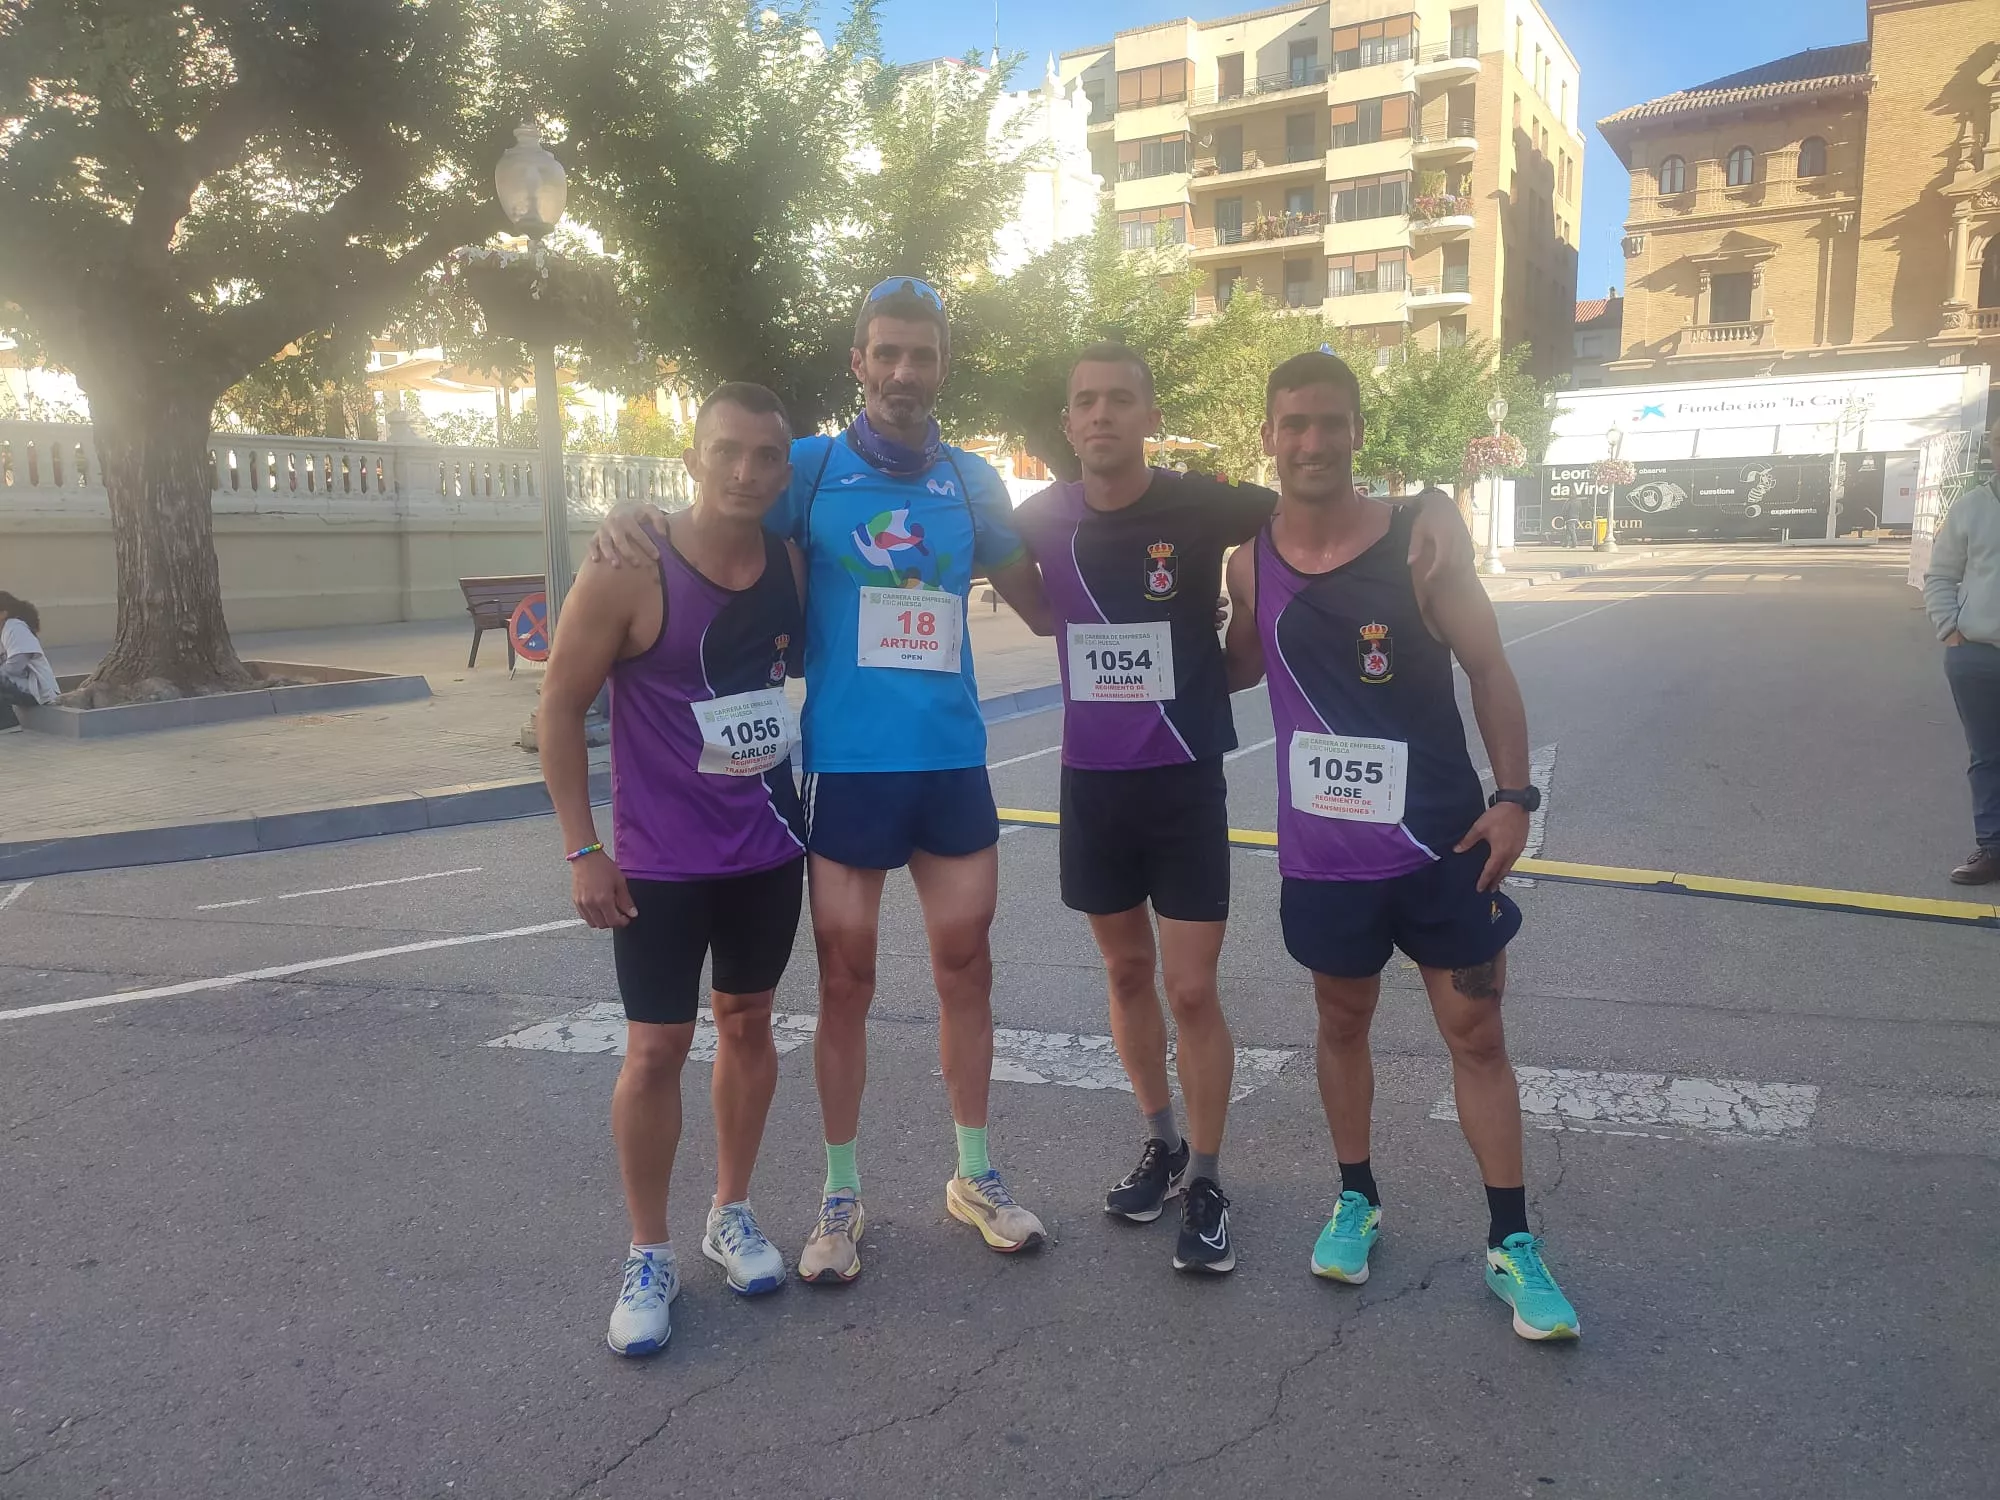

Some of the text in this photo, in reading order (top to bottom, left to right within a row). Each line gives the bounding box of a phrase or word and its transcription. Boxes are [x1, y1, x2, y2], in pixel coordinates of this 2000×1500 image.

[1678, 400, 1777, 413] Fundación
[1550, 481, 1610, 496] da Vinc
[1699, 488, 1735, 496] cuestiona
[1770, 507, 1818, 516] experimenta
[882, 593, 912, 601] CARRERA
[897, 610, 936, 636] 18
[880, 637, 939, 651] ARTURO
[900, 653, 923, 661] OPEN
[1085, 649, 1153, 671] 1054
[720, 716, 780, 747] 1056
[731, 743, 777, 760] CARLOS
[1324, 746, 1350, 754] HUESCA
[1349, 742, 1386, 750] EMPRESAS
[1308, 756, 1383, 784] 1055
[1323, 785, 1363, 799] JOSE
[1315, 794, 1360, 806] REGIMIENTO
[1311, 802, 1370, 815] TRANSMISIONES
